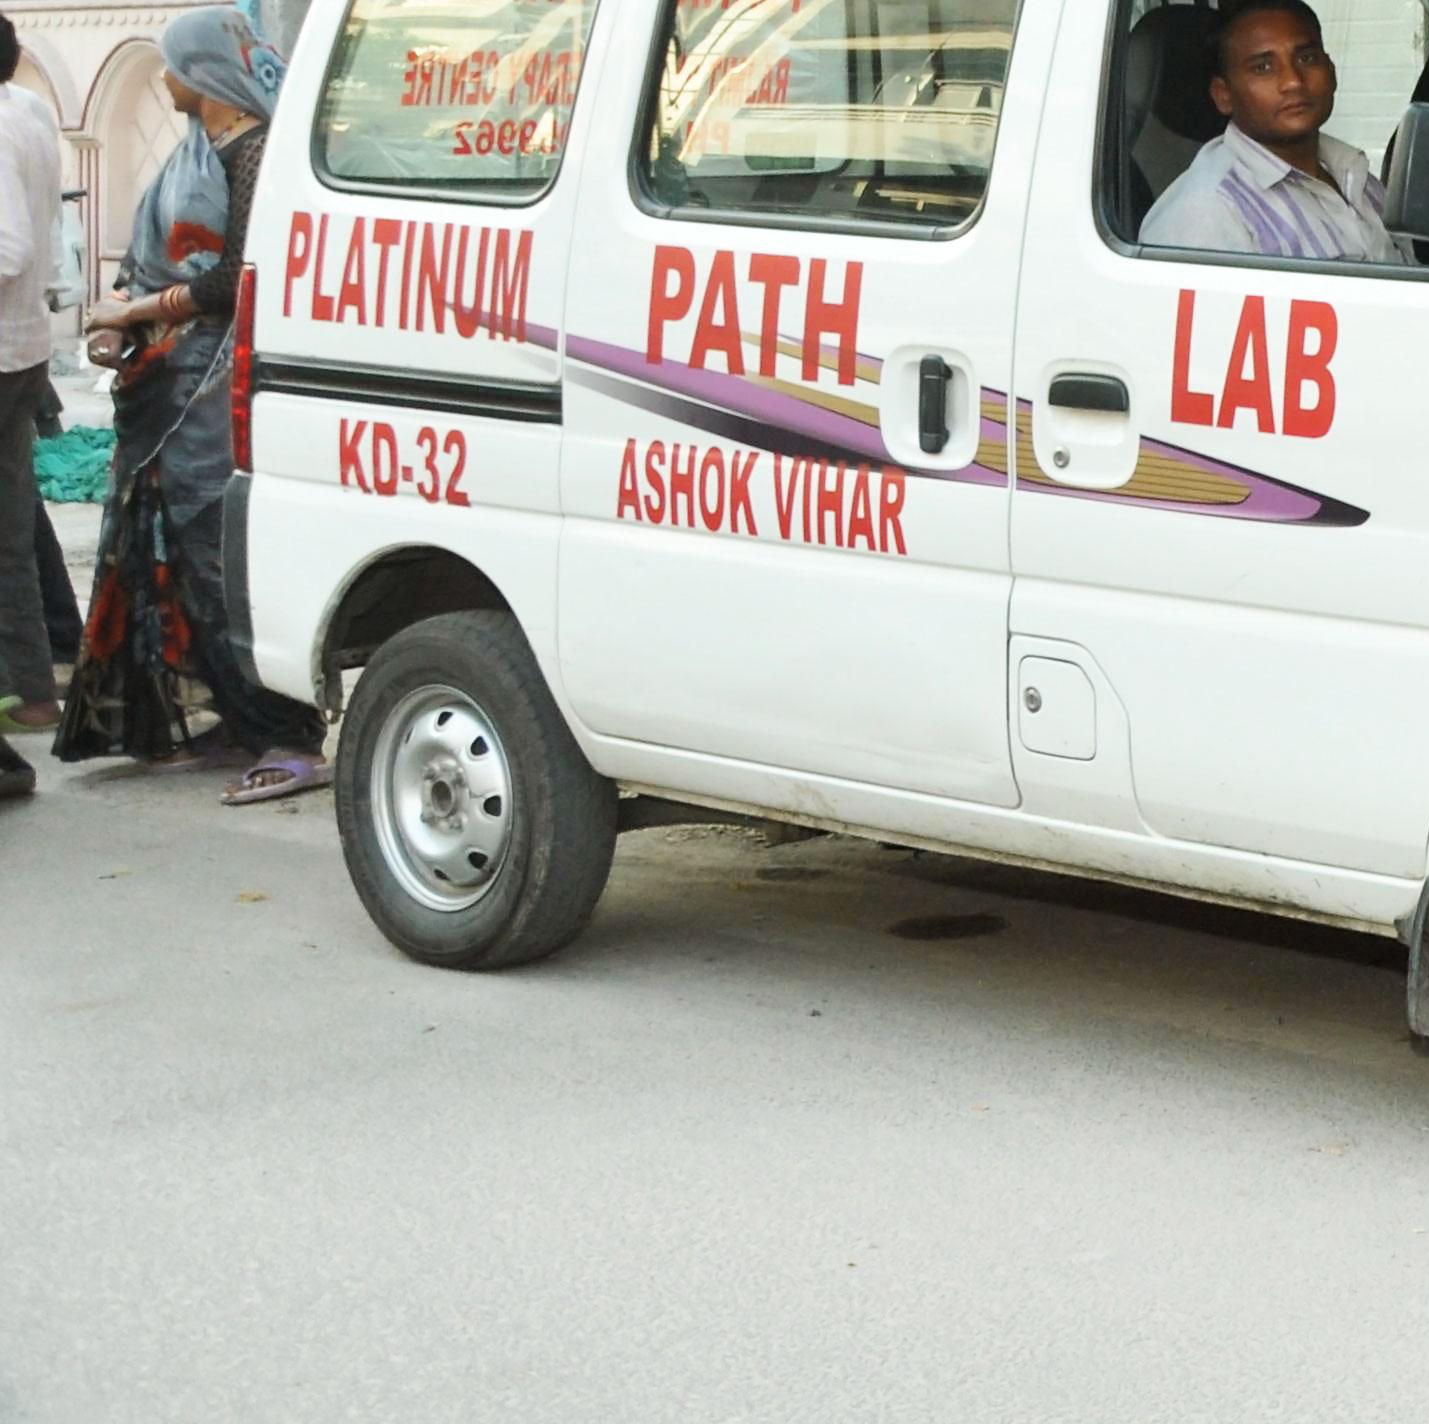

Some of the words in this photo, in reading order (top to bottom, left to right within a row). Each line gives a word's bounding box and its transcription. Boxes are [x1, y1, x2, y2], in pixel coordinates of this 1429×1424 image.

[282, 211, 534, 343] PLATINUM
[646, 244, 864, 387] PATH
[1170, 288, 1339, 439] LAB
[338, 418, 472, 508] KD-32
[617, 438, 758, 537] ASHOK
[774, 452, 909, 556] VIHAR
